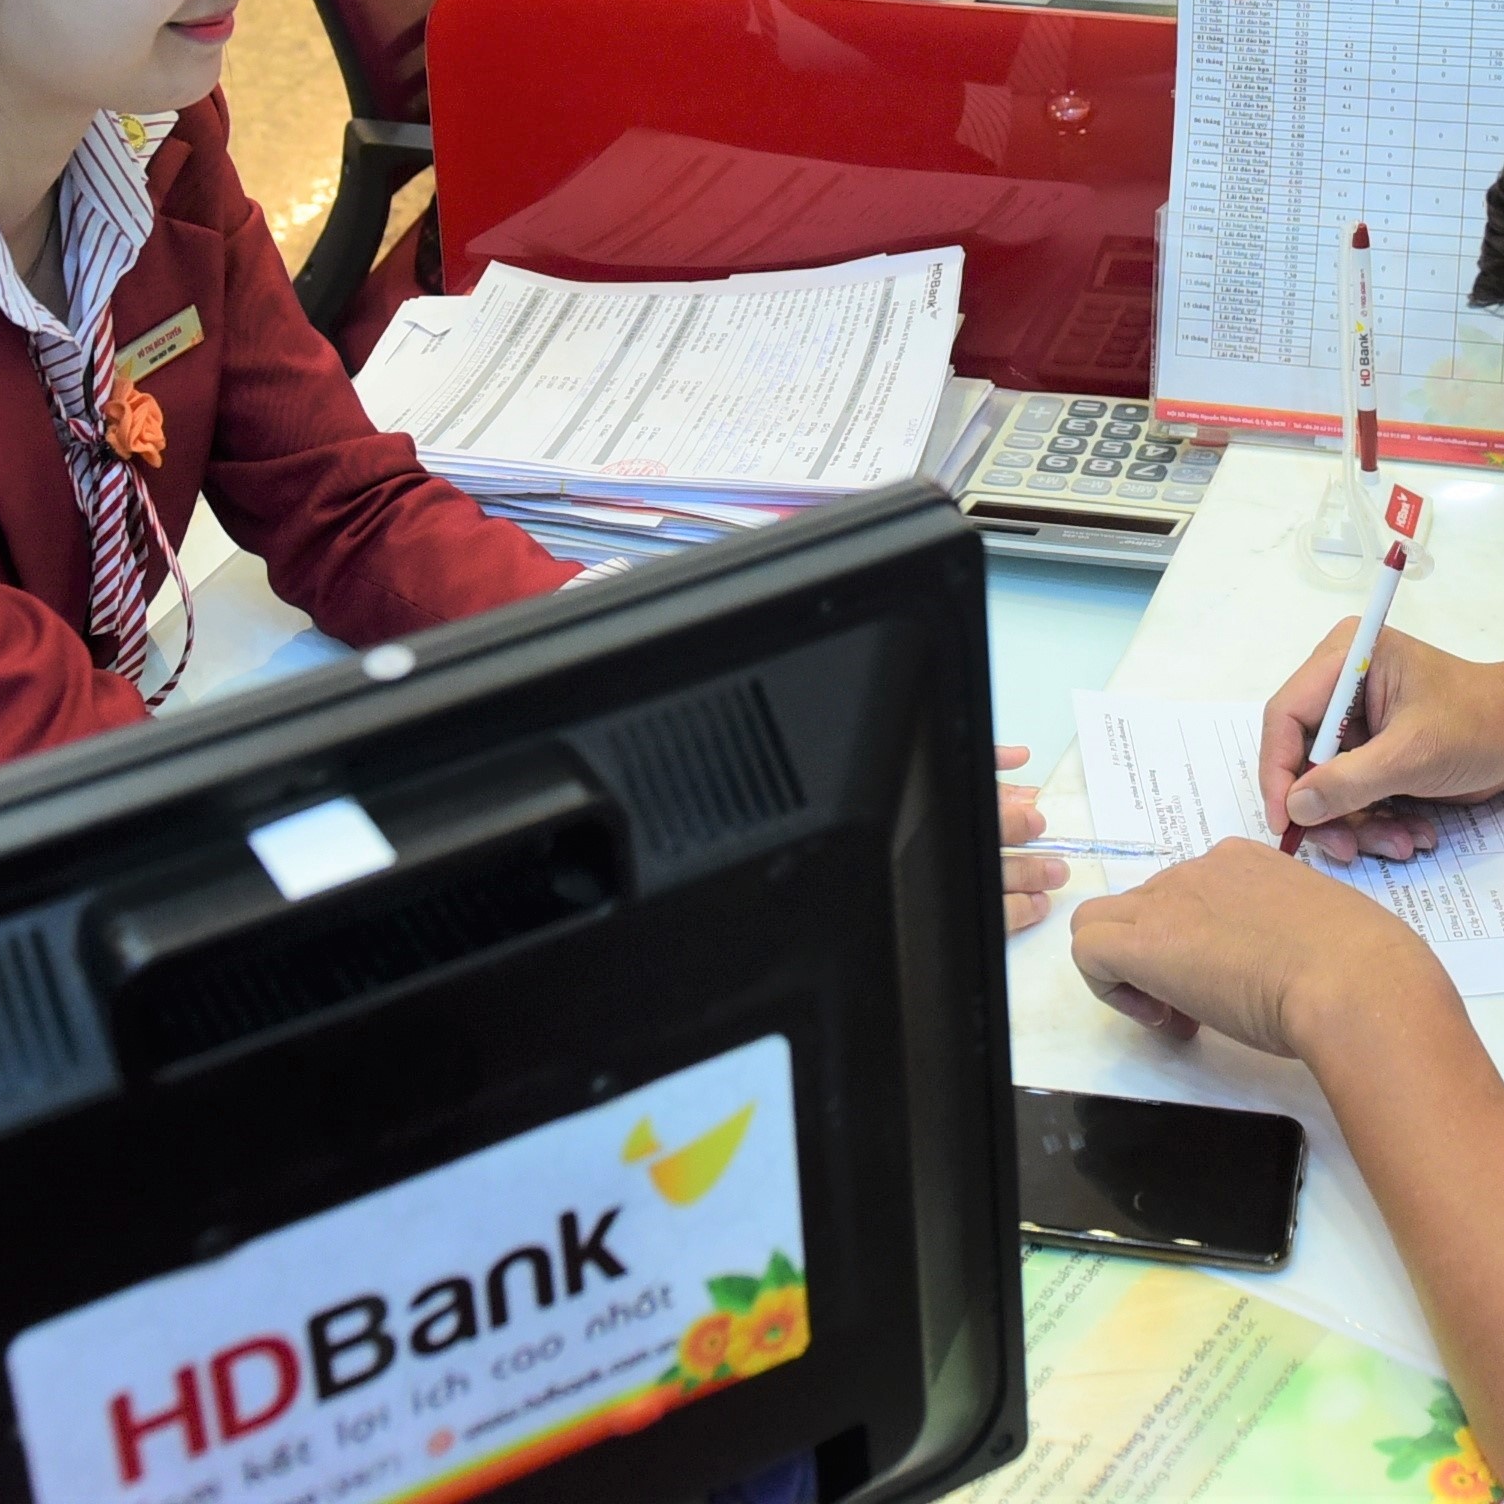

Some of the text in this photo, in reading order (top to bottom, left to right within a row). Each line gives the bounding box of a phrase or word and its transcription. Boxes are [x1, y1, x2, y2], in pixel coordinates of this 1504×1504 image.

[927, 262, 943, 310] HDBank
[1066, 419, 1134, 434] 3 2
[1057, 438, 1169, 456] 6 5 4
[1046, 456, 1156, 477] 9 8 7
[1121, 483, 1154, 494] MRC
[106, 1204, 629, 1489] HDBank
[489, 1334, 565, 1380] cao
[584, 1283, 674, 1341] nhất
[1115, 1429, 1146, 1463] hàng
[1153, 1382, 1184, 1417] dụng
[1192, 1336, 1218, 1364] dịch
[1225, 1295, 1252, 1324] giao
